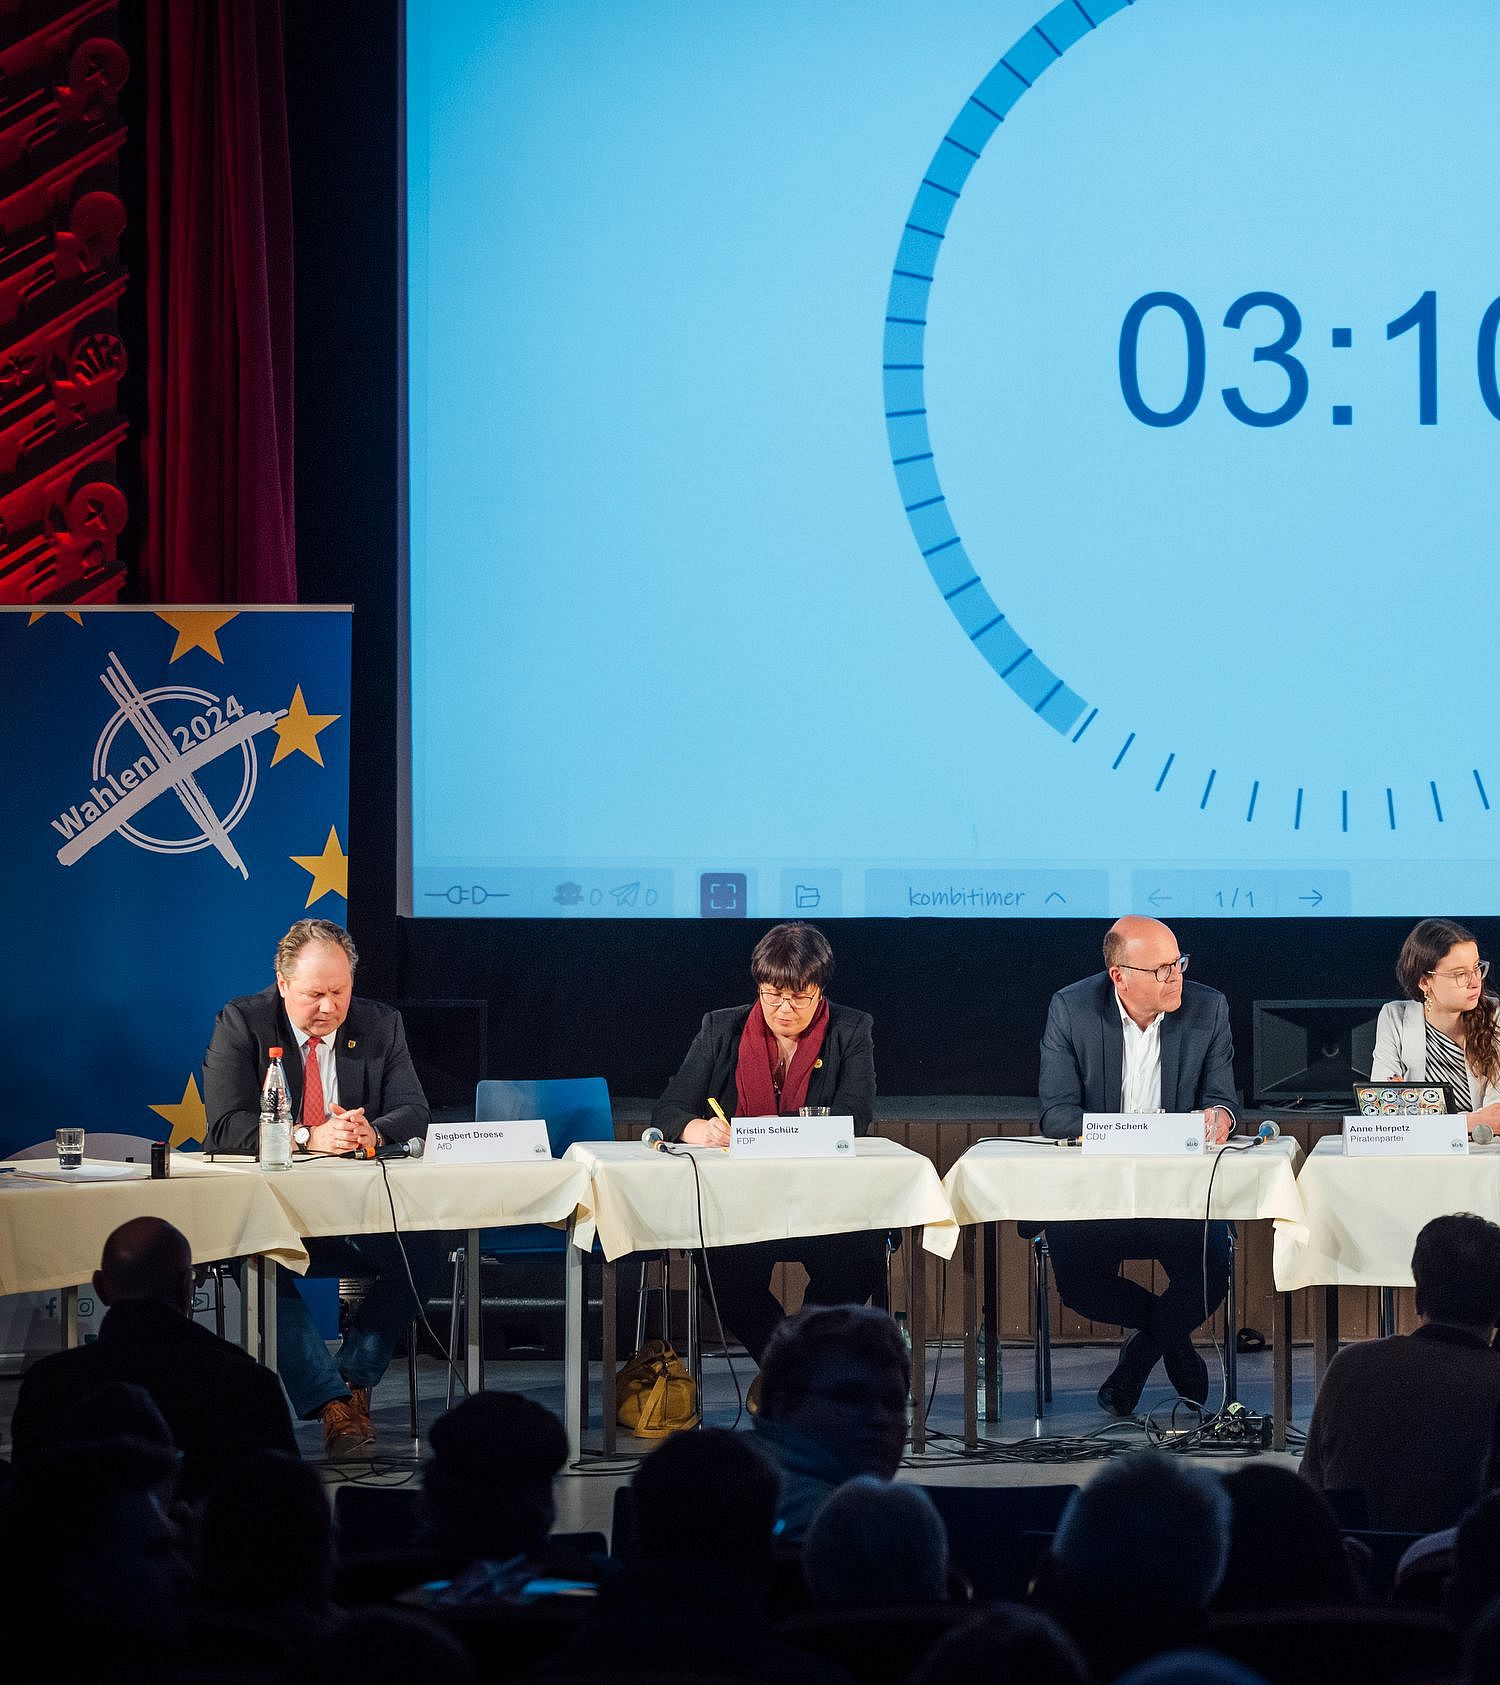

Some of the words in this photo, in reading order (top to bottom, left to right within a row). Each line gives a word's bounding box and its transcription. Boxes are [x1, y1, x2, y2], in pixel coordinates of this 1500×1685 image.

[50, 753, 158, 841] Wahlen
[172, 695, 244, 752] 2024
[908, 886, 1026, 907] kombitimer
[736, 1126, 766, 1135] Kristin
[1086, 1122, 1112, 1131] Oliver
[1115, 1122, 1149, 1131] Schenk
[1349, 1125, 1373, 1133] Anne
[1375, 1125, 1410, 1134] Herpetz
[435, 1131, 472, 1142] Siegbert
[473, 1131, 504, 1140] Droese
[736, 1137, 756, 1145] FDP
[1085, 1132, 1107, 1141] CDU
[1350, 1135, 1404, 1144] Piratenpartei
[436, 1142, 453, 1151] AfD
